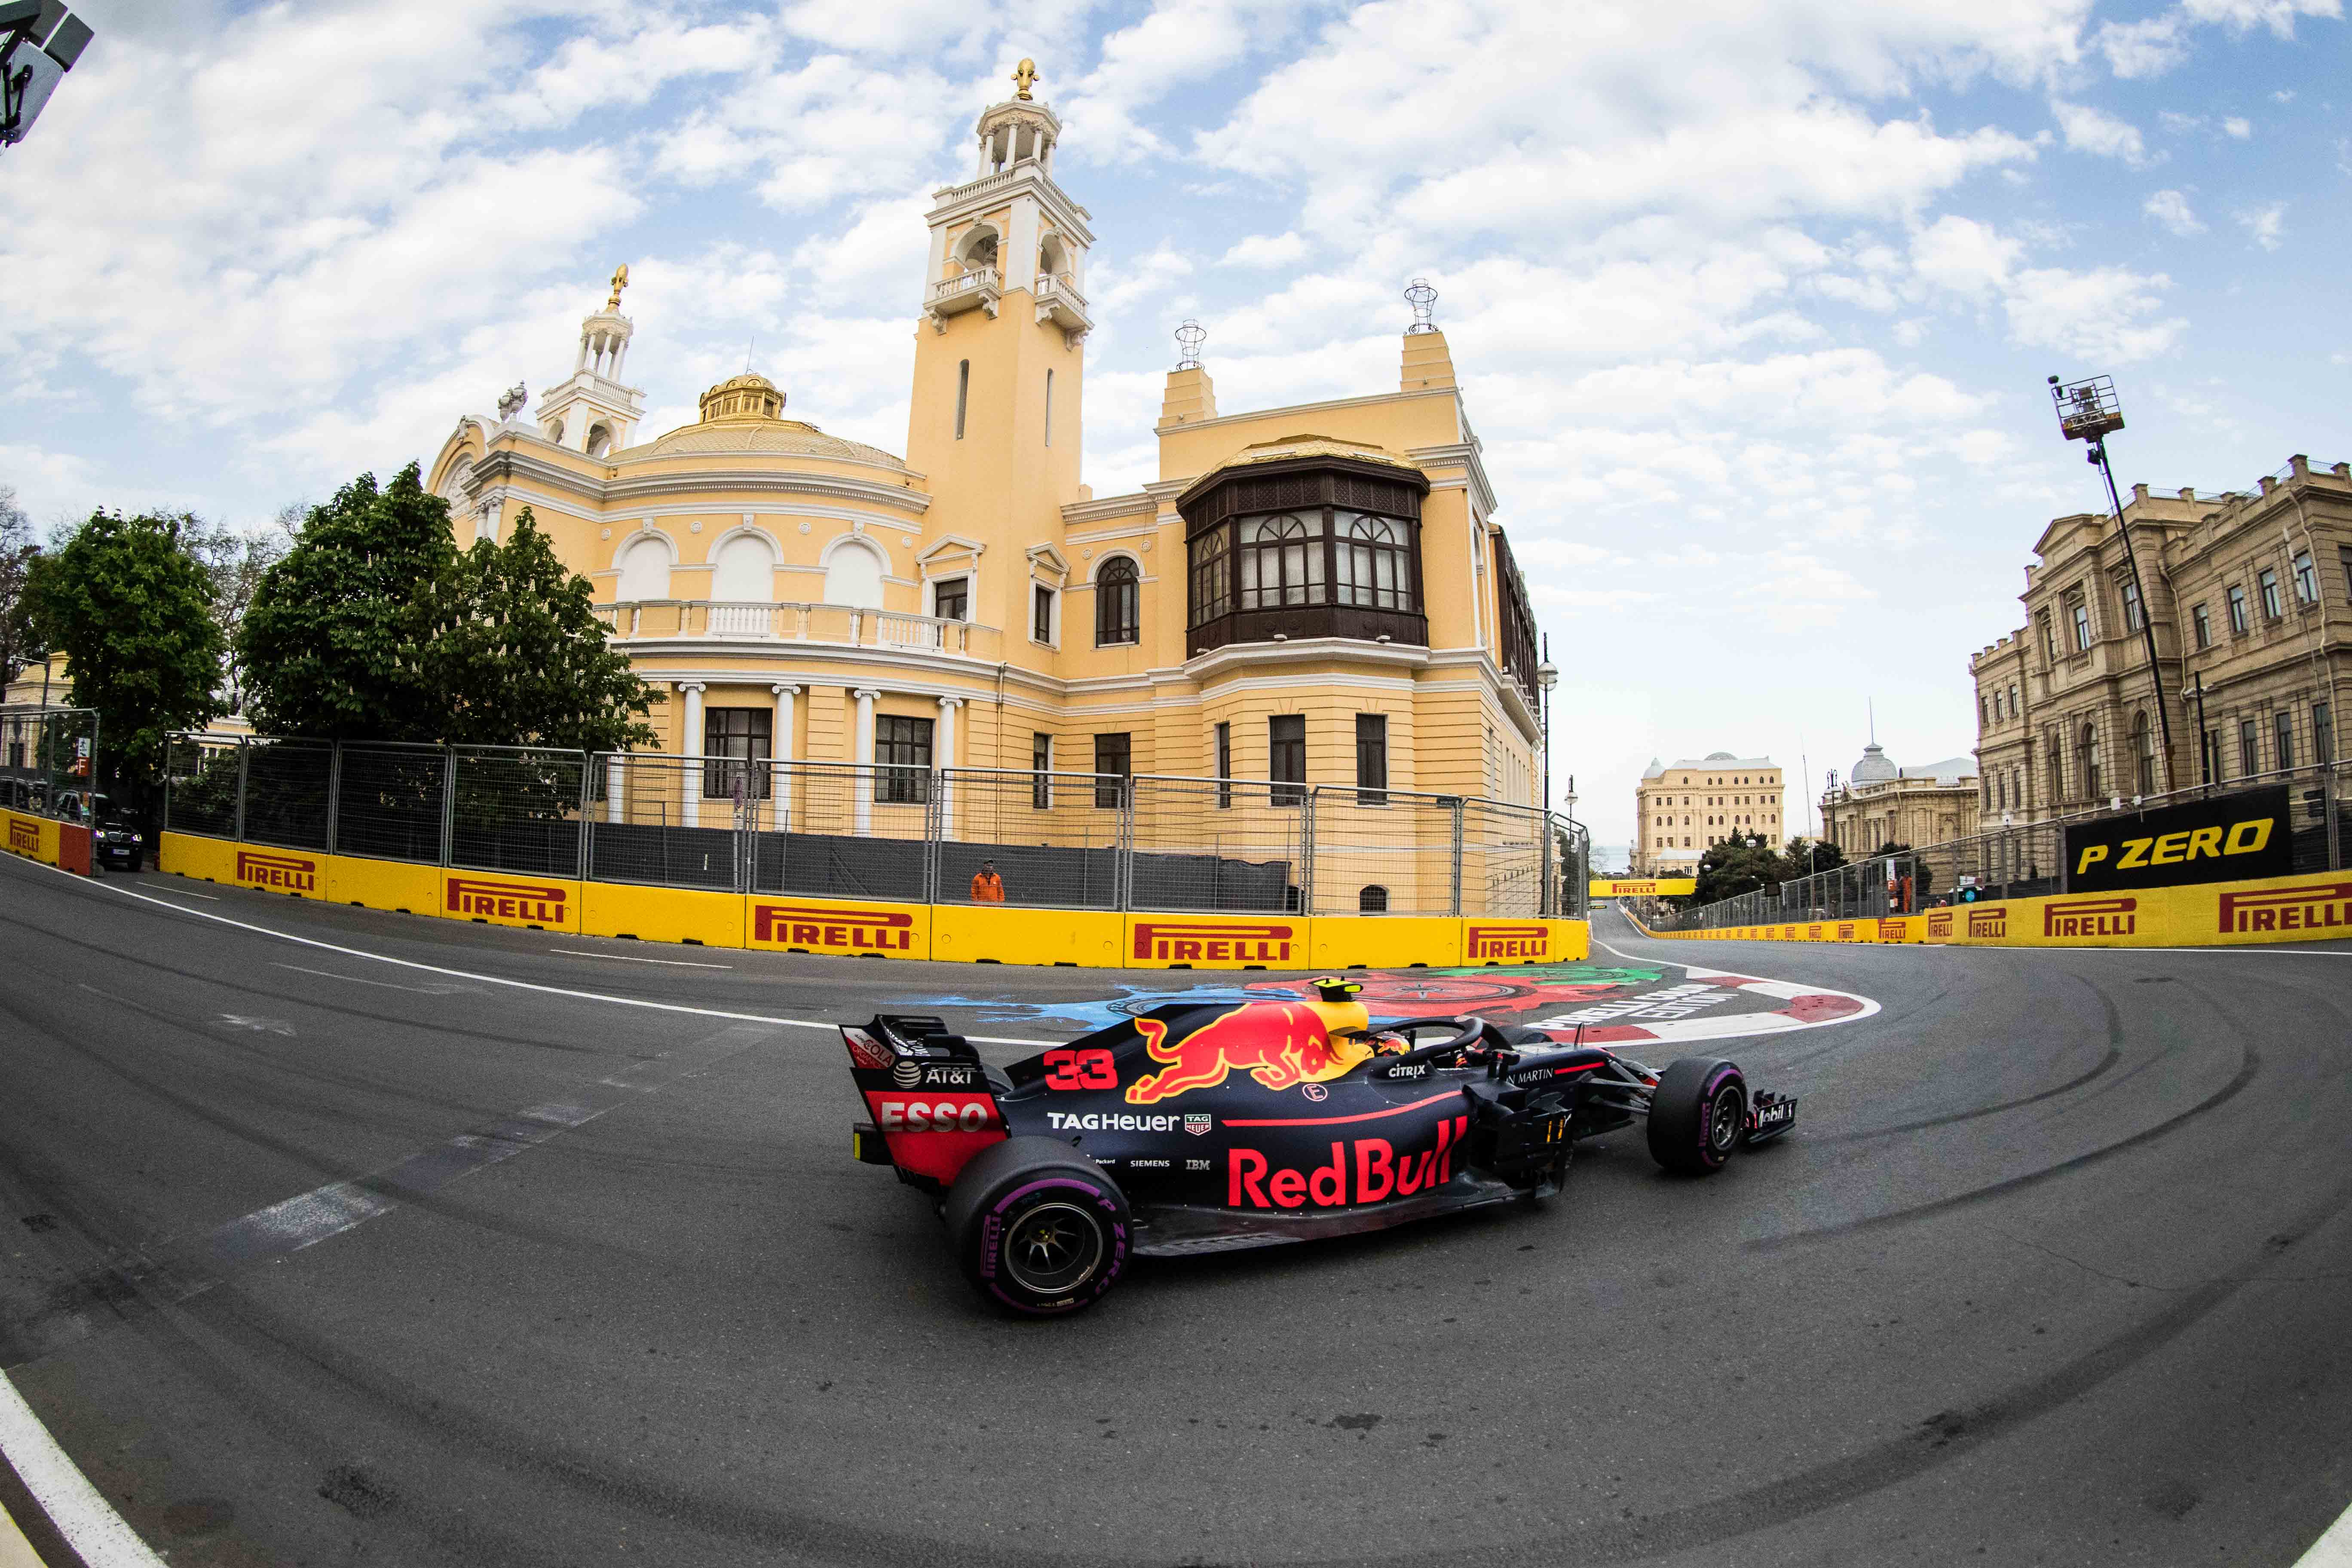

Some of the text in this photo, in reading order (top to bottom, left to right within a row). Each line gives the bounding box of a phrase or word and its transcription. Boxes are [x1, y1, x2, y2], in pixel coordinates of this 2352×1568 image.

[9, 818, 39, 852] PIRELLI
[2077, 818, 2274, 874] P ZERO
[237, 851, 315, 891] PIRELLI
[447, 878, 566, 923] PIRELLI
[1612, 883, 1656, 894] PIRELLI
[1969, 908, 2006, 937] PIRELLI
[2044, 898, 2137, 937] PIRELLI
[2219, 882, 2352, 933] PIRELLI
[755, 905, 913, 949] PIRELLI
[1879, 922, 1906, 939] PIRELLI
[1928, 912, 1953, 937] PIRELLI
[1134, 923, 1293, 961] PIRELLI
[1468, 927, 1548, 958] PIRELLI
[864, 1039, 893, 1066] COLA
[925, 1067, 978, 1084] AT&T
[1043, 1049, 1118, 1090] 33
[1518, 1068, 1553, 1084] MARTIN
[882, 1102, 988, 1133] ESSO
[1187, 1124, 1209, 1133] HEUER
[1186, 1159, 1211, 1170] IBM
[1228, 1115, 1467, 1208] Red Bull
